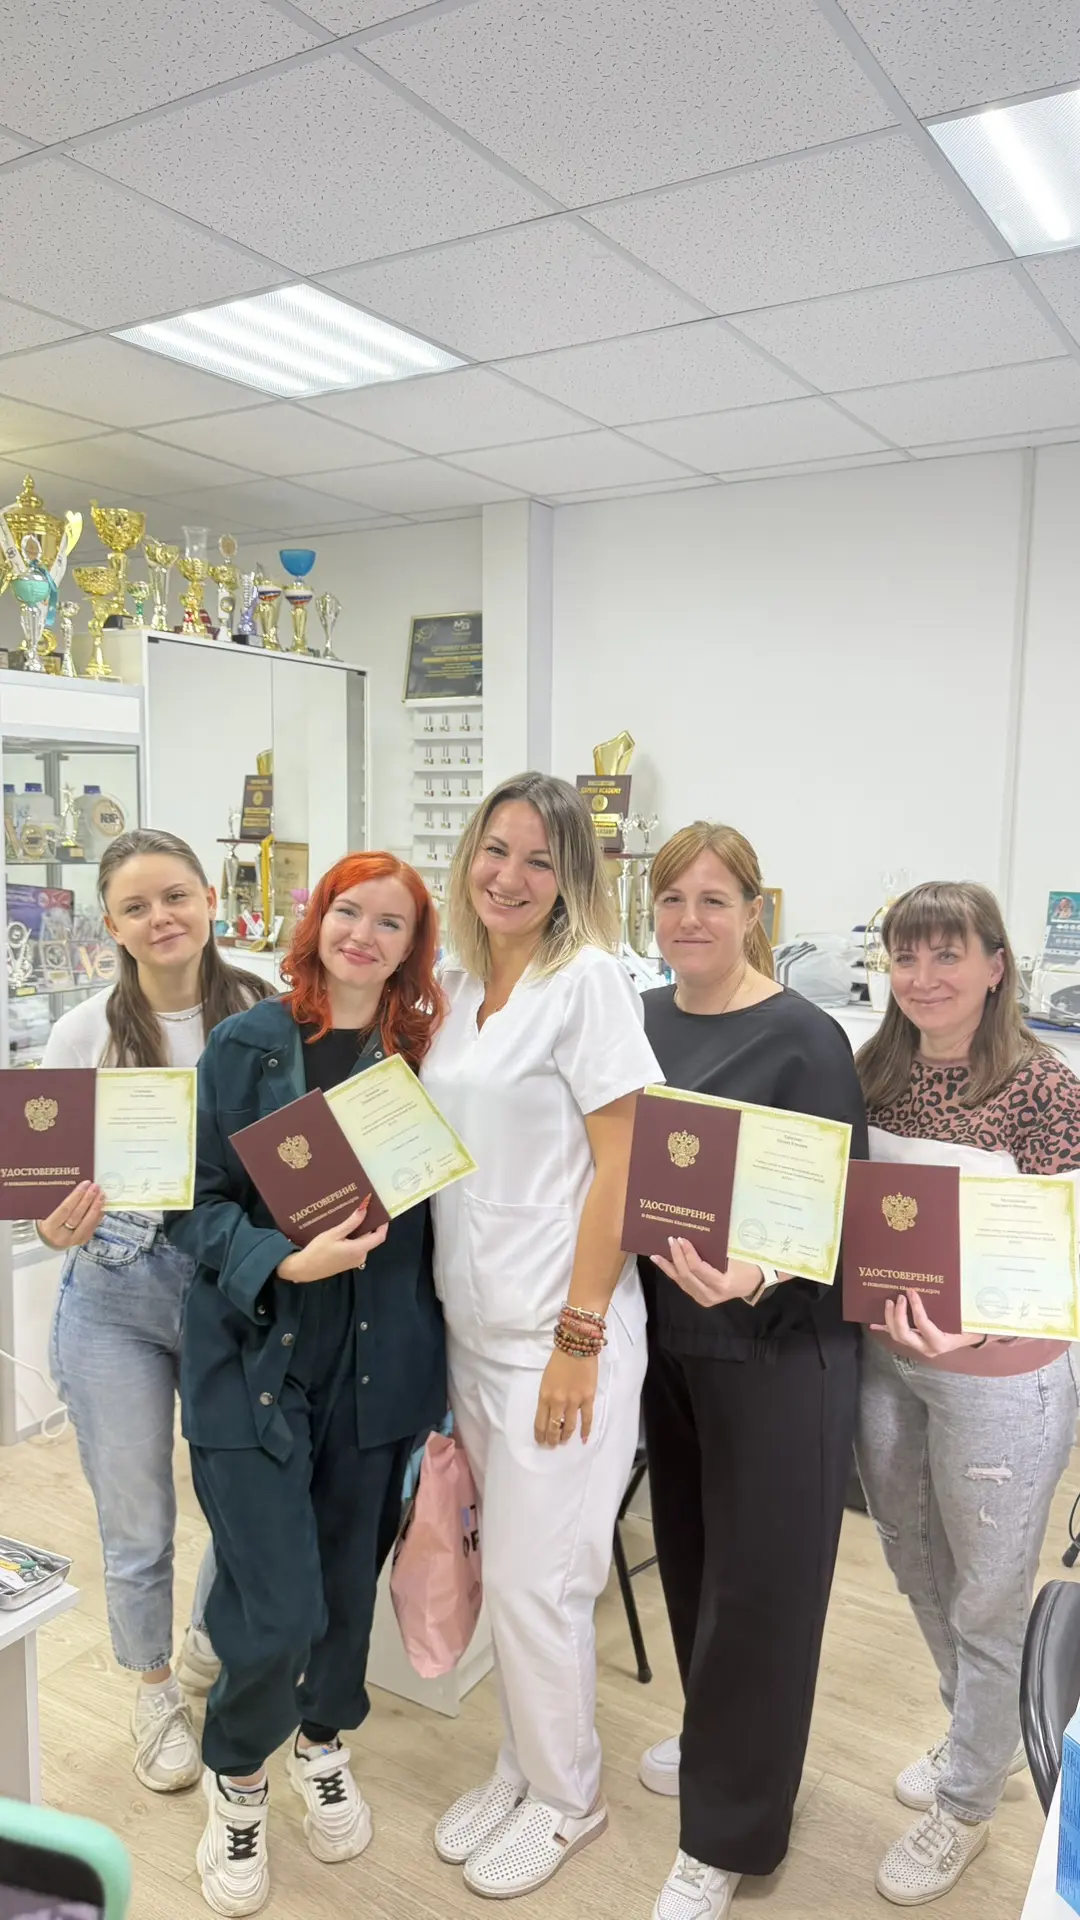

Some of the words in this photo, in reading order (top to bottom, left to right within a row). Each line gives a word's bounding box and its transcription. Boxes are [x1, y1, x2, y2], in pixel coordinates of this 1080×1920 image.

[0, 1166, 80, 1178] УДОСТОВЕРЕНИЕ
[289, 1182, 358, 1223] УДОСТОВЕРЕНИЕ
[639, 1198, 715, 1222] УДОСТОВЕРЕНИЕ
[858, 1266, 945, 1284] УДОСТОВЕРЕНИЕ
